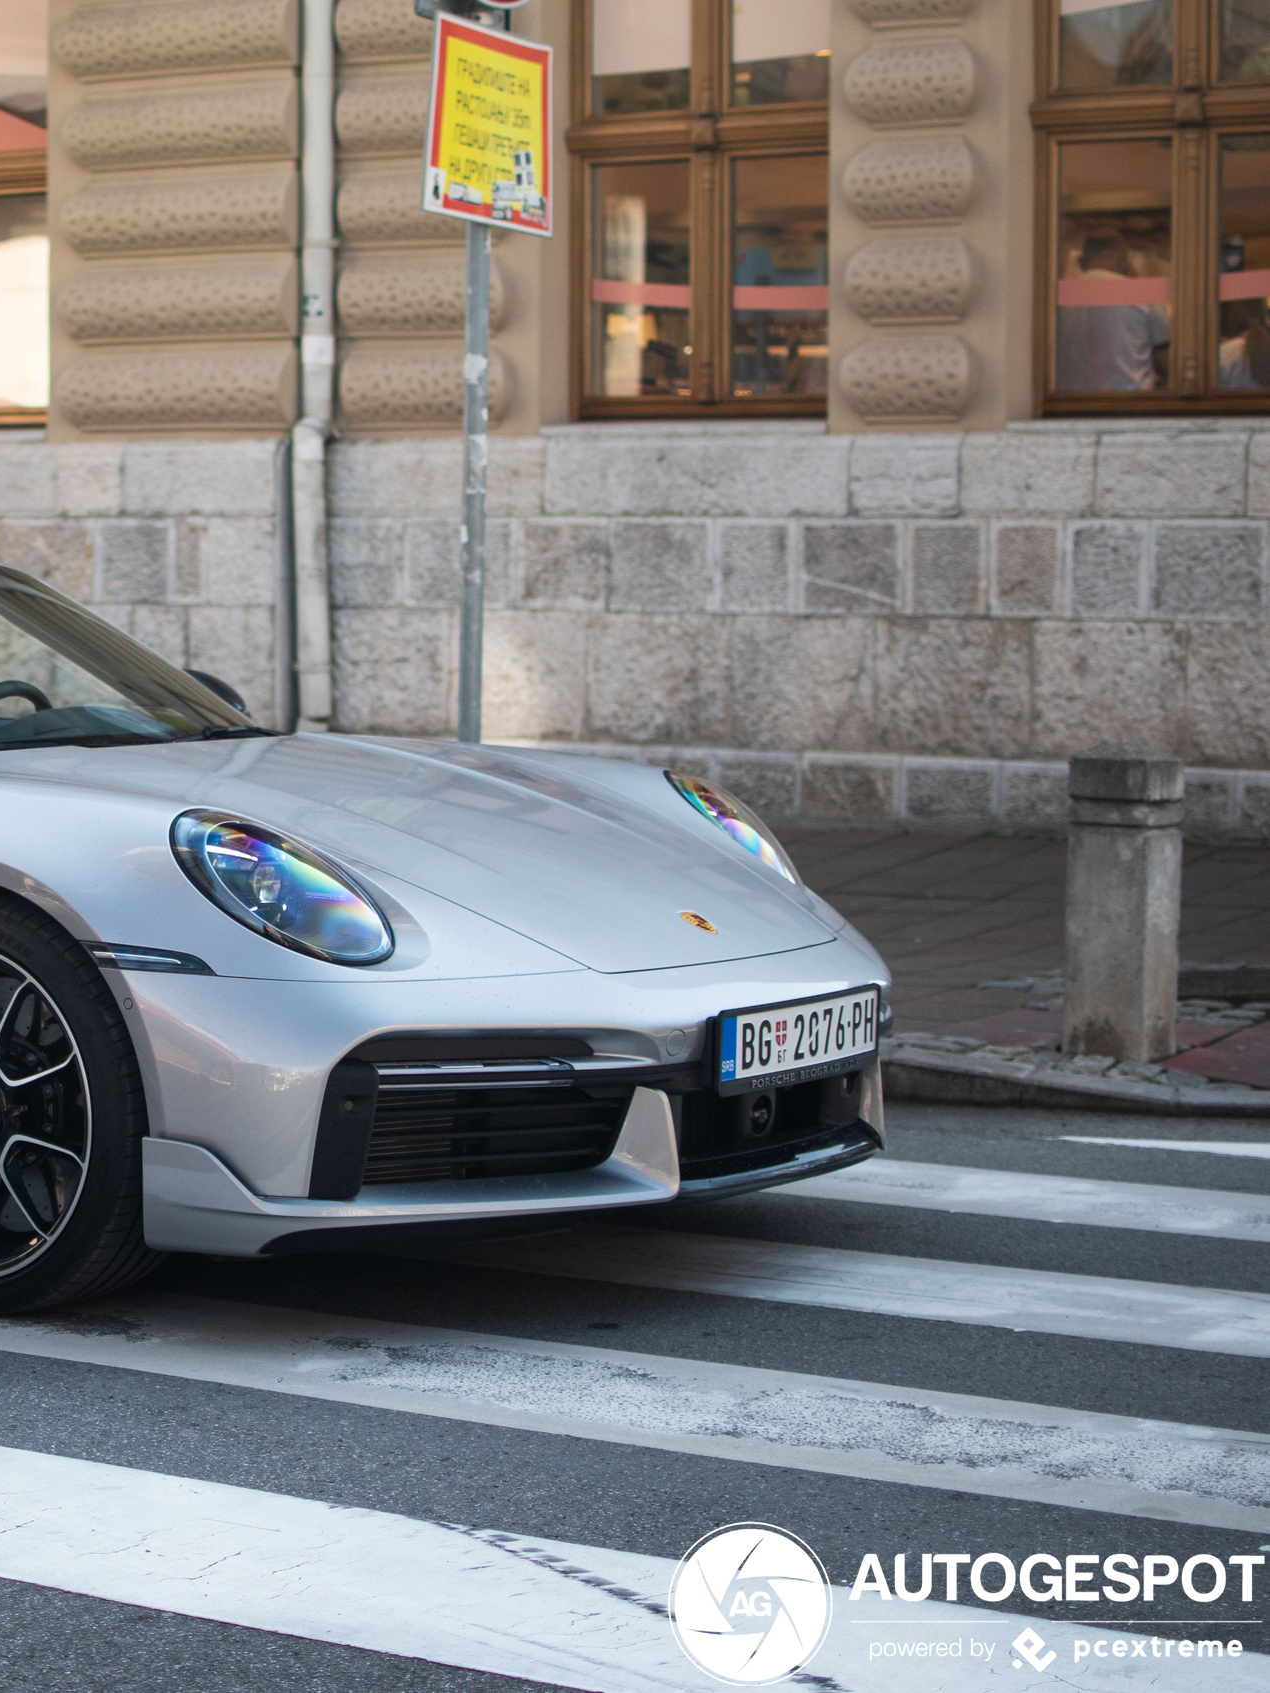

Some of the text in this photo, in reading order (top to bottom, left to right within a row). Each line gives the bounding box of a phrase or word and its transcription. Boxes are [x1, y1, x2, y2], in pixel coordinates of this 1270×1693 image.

[742, 1019, 771, 1070] BG
[777, 1048, 787, 1063] БГ
[721, 1059, 734, 1073] SRB
[752, 1072, 795, 1089] PORSCHE
[800, 1063, 840, 1080] BEOGRAD
